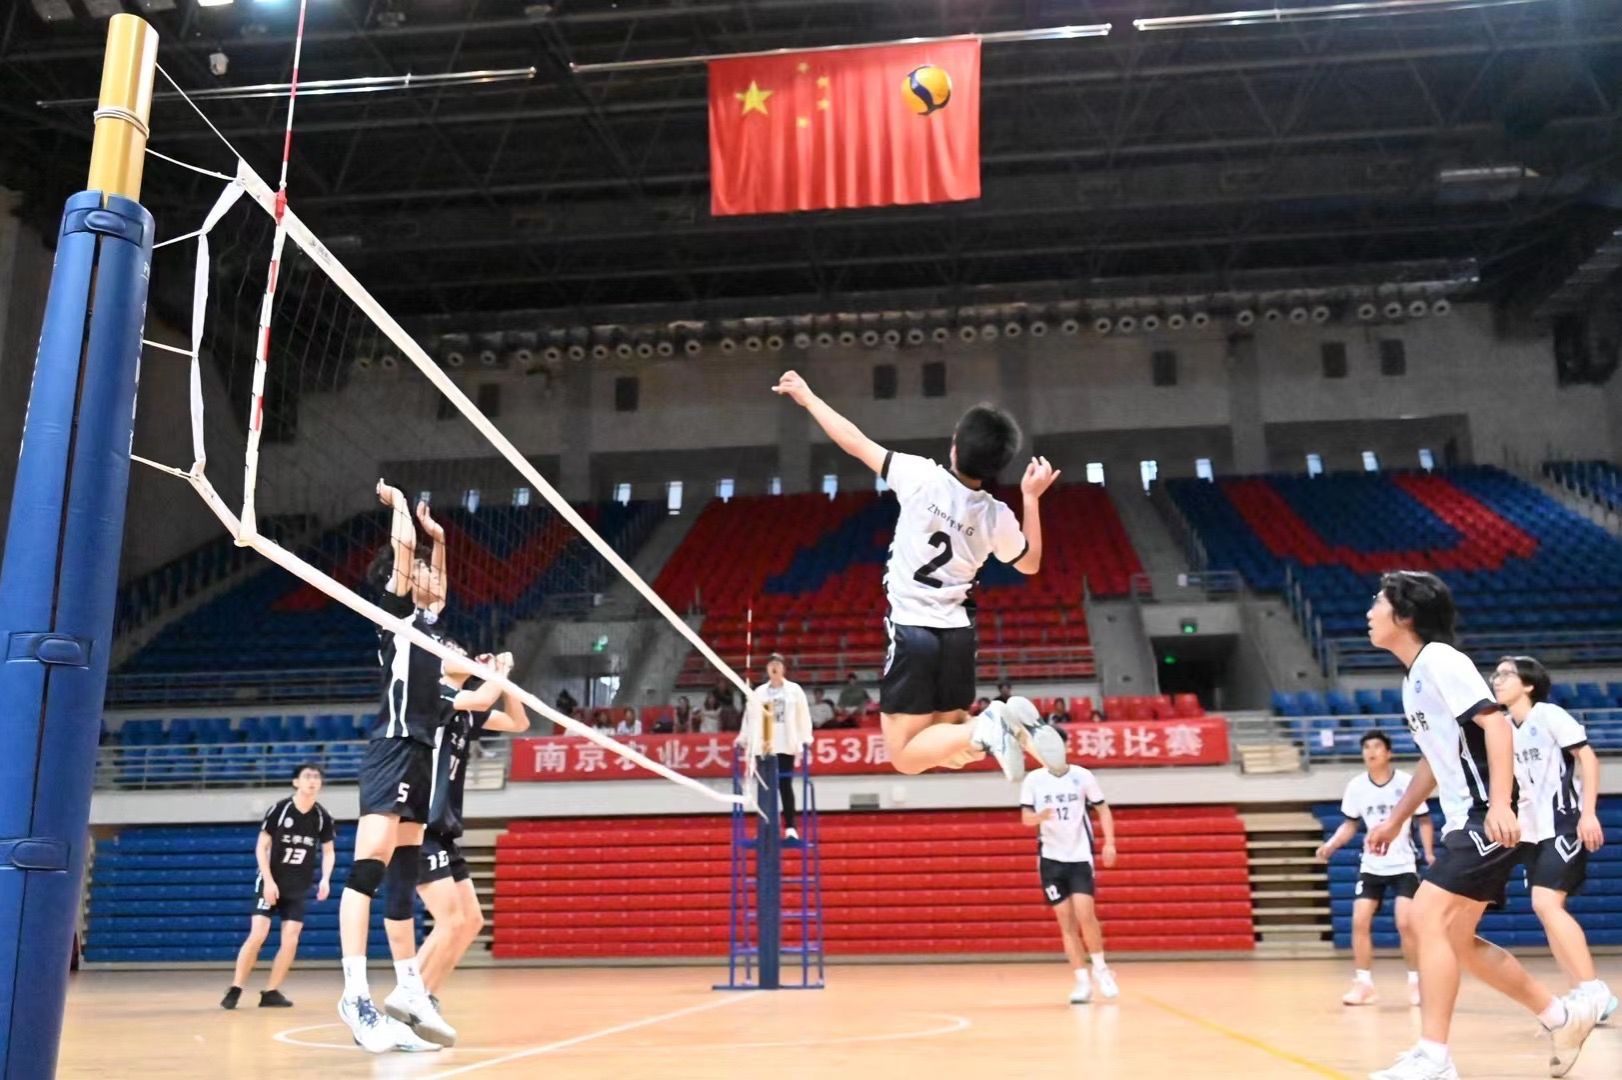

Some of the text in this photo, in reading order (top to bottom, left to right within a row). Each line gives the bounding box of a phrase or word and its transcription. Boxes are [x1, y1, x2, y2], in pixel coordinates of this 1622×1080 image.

[913, 531, 953, 588] 2
[397, 781, 410, 803] 5
[1056, 807, 1070, 820] 12
[282, 847, 307, 865] 13
